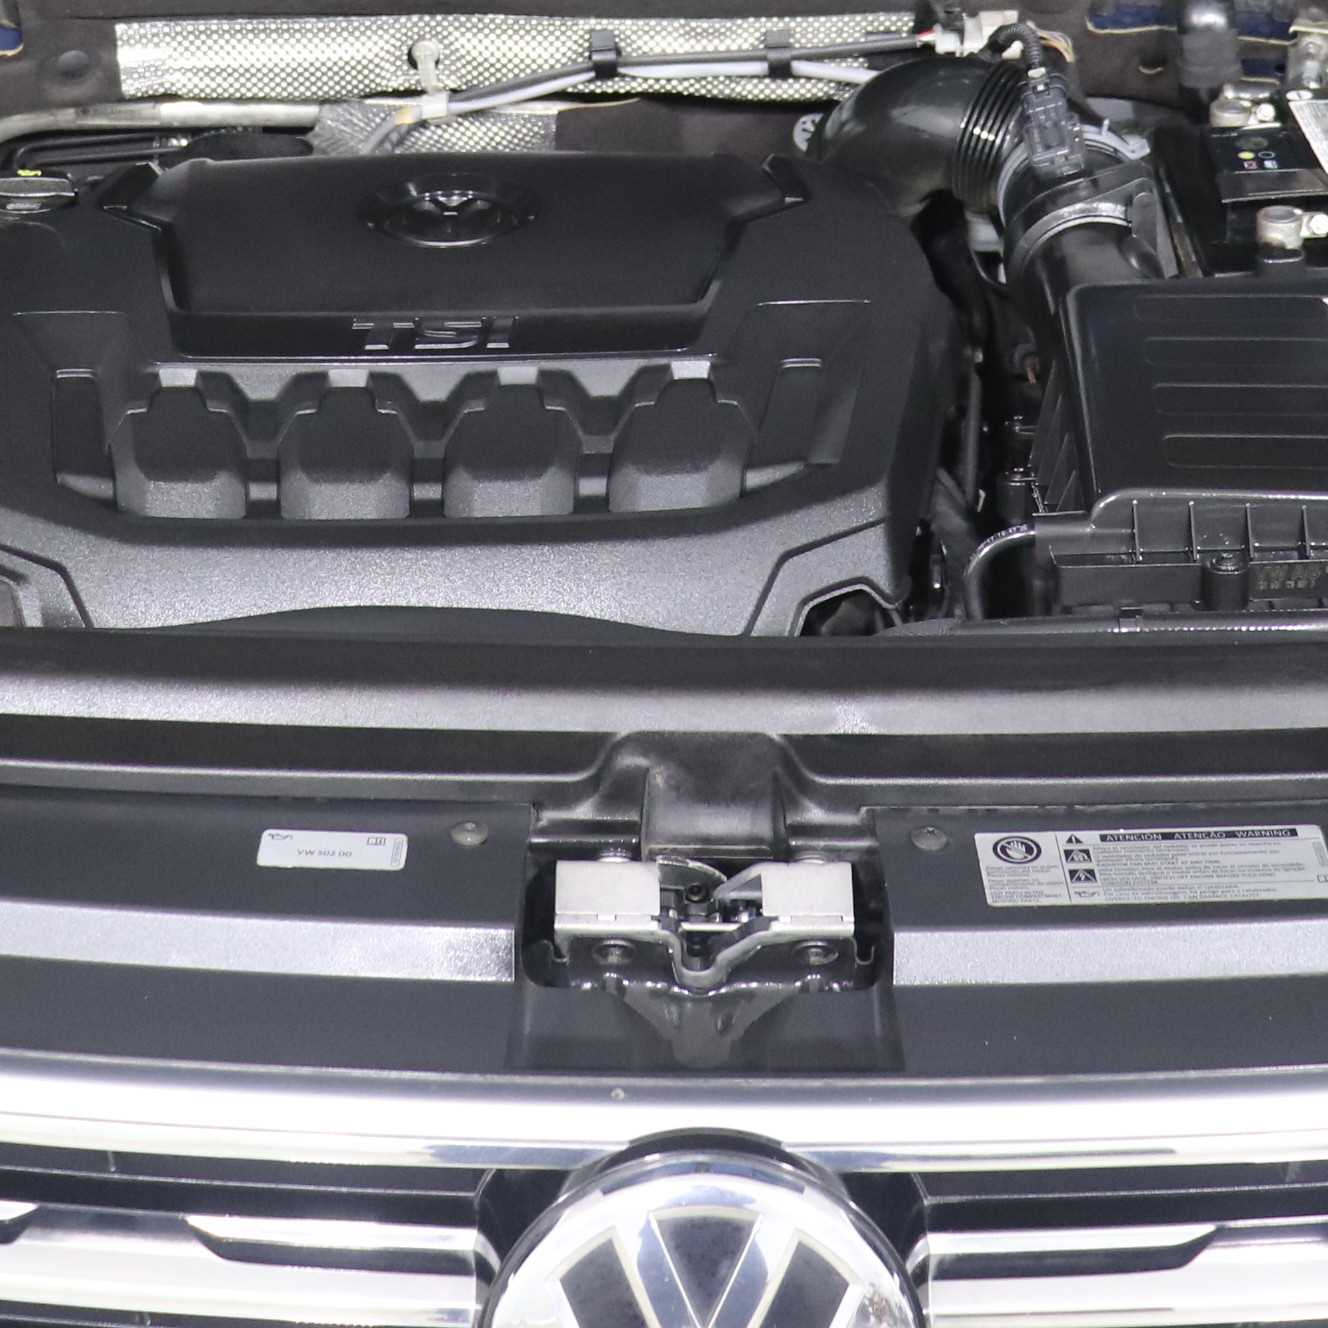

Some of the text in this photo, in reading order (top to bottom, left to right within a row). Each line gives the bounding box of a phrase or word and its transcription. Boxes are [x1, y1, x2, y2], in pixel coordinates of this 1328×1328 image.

[352, 316, 518, 351] TSI
[1235, 828, 1291, 838] WARNING
[296, 847, 316, 857] VW
